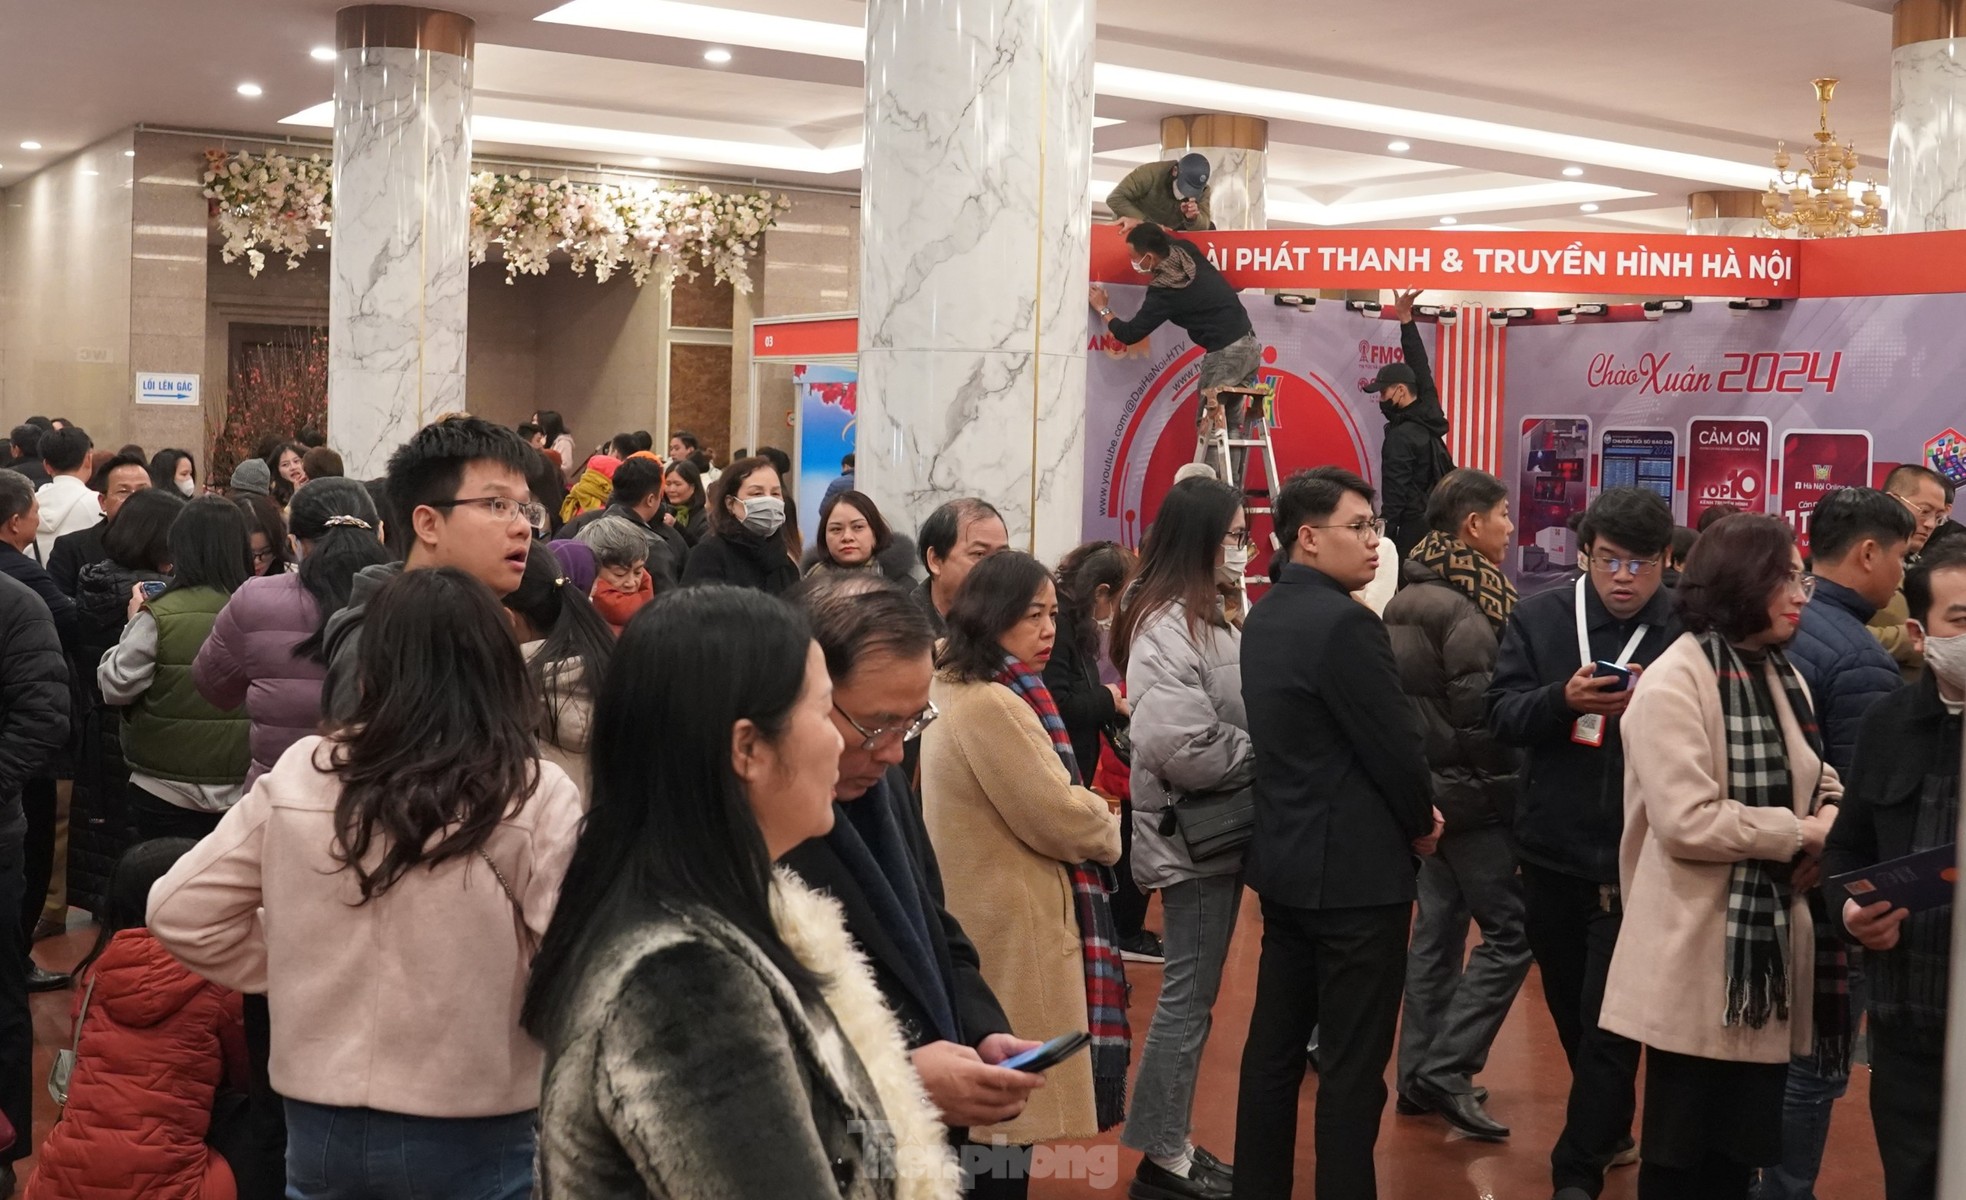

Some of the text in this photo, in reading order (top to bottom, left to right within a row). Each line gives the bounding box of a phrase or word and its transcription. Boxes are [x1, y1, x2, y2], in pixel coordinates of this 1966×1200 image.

[1205, 241, 1792, 286] ÀI PHÁT THANH & TRUYỀN HÌNH HÀ NỘI
[764, 335, 774, 348] 03
[1371, 345, 1404, 364] FM9
[1172, 362, 1202, 393] www.h
[1587, 351, 1842, 395] Chào Xuân 2024
[143, 378, 193, 391] LỐI LÊN GÁC
[1699, 426, 1761, 446] CẢM ƠN
[1813, 483, 1825, 492] Nội
